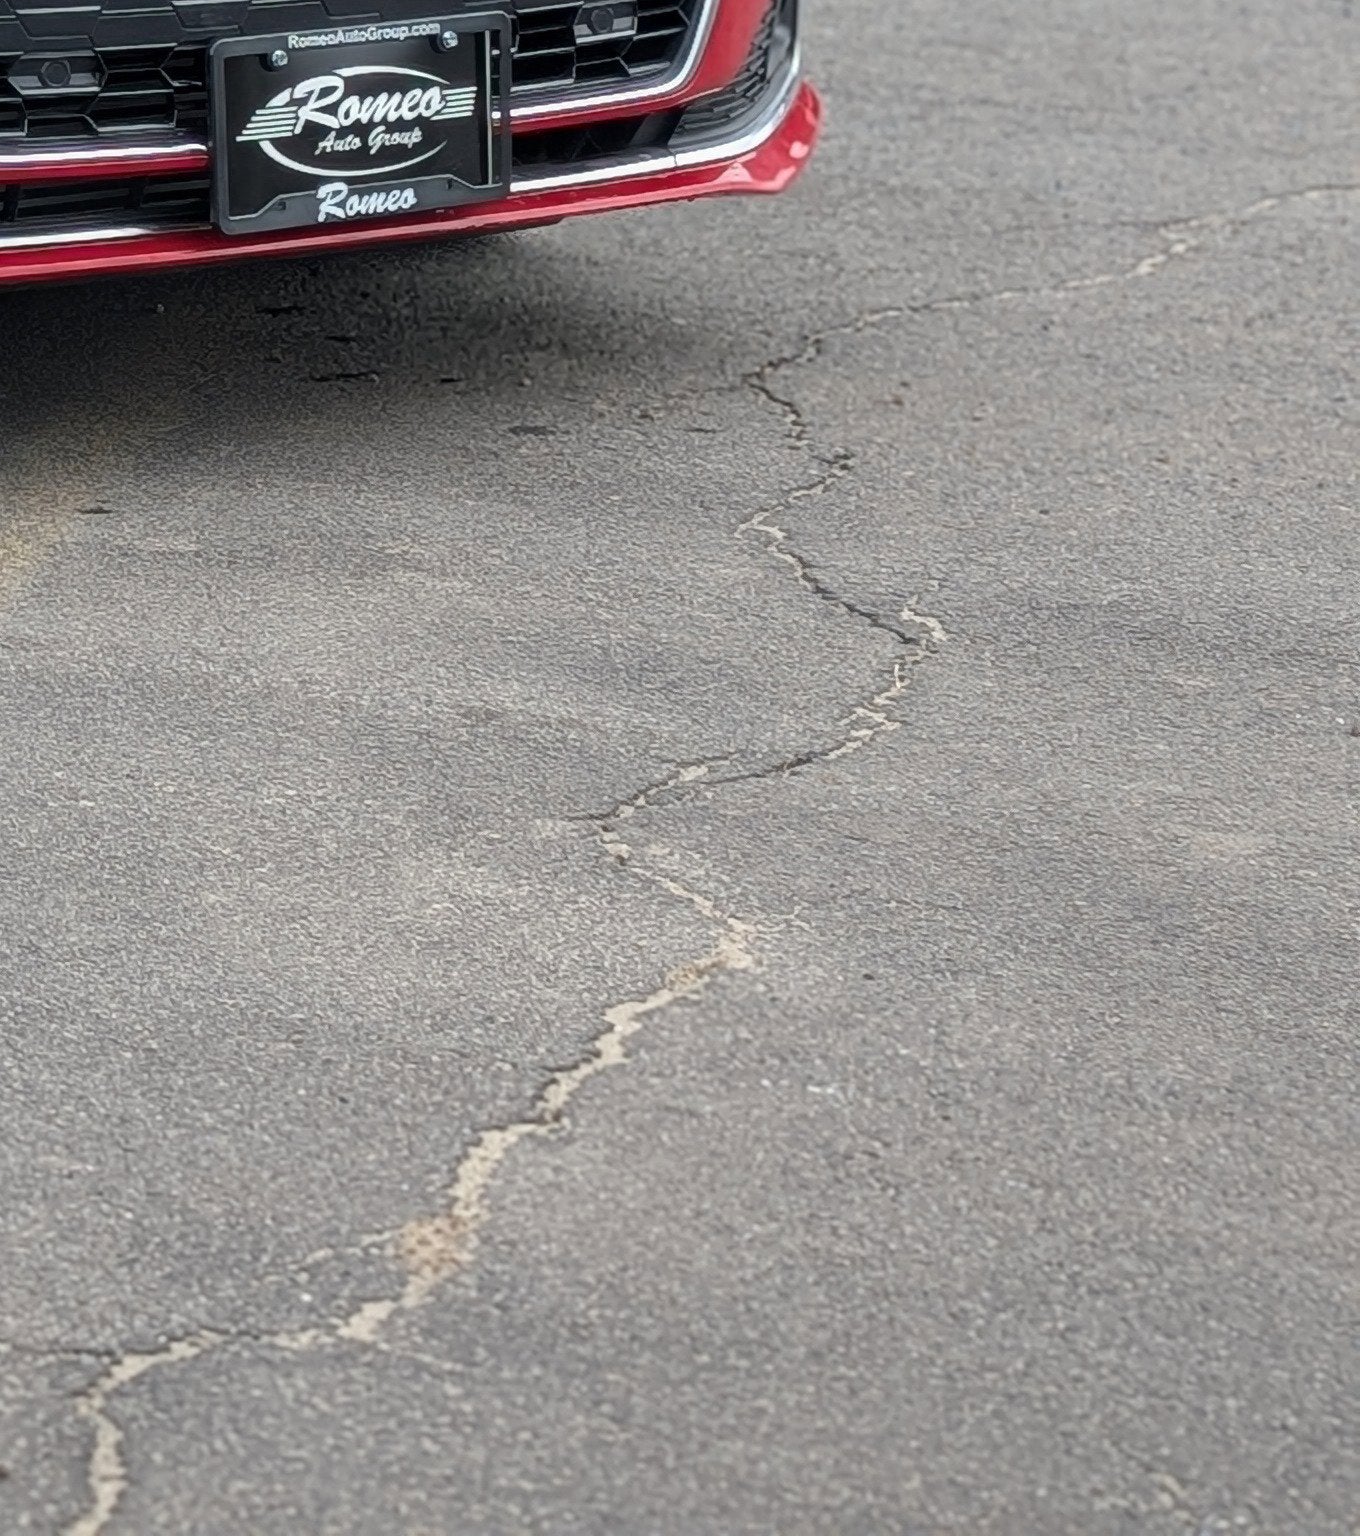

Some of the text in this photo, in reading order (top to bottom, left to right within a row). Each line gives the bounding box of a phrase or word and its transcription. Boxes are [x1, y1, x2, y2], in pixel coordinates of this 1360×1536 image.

[288, 22, 440, 49] RomeoAutoGroup.com
[293, 75, 448, 135] Romeo
[314, 125, 423, 155] Auto Group
[316, 181, 418, 222] Romeo
